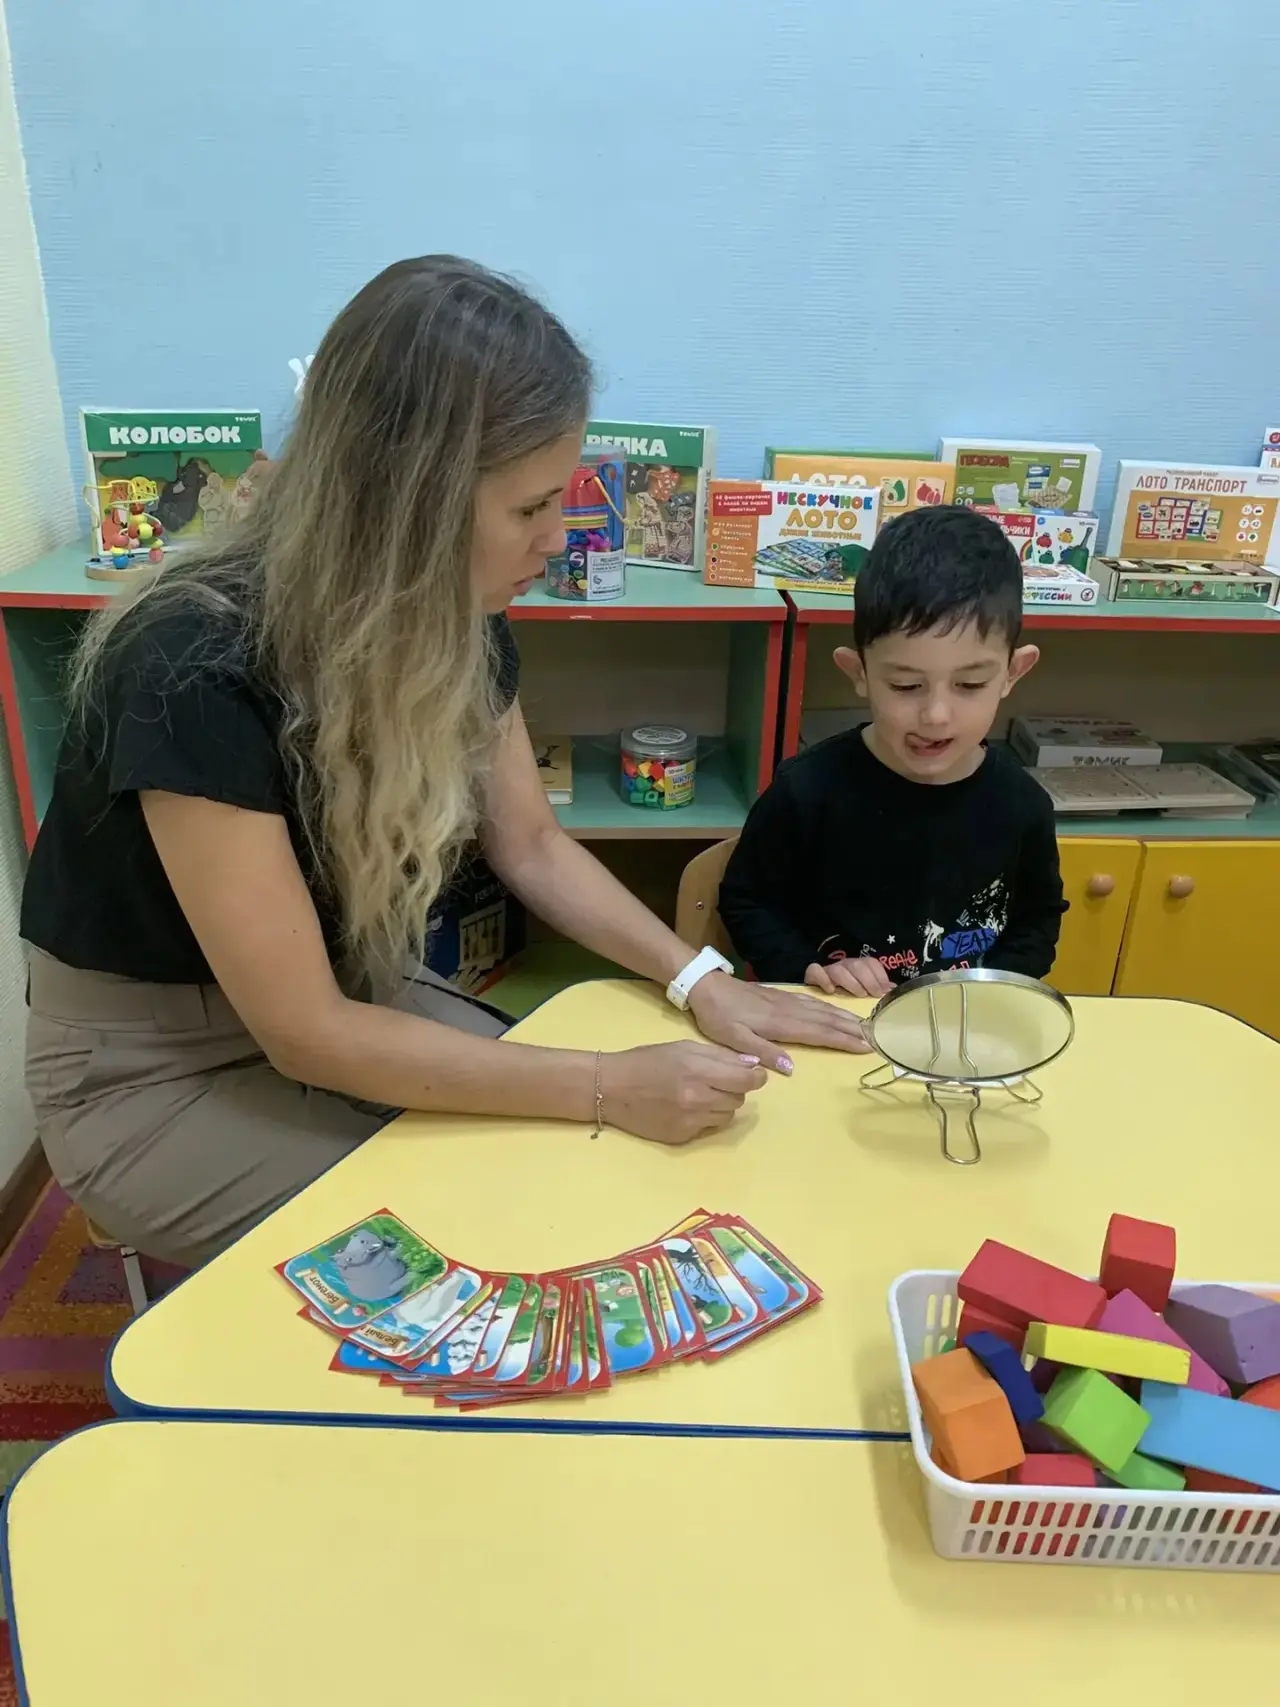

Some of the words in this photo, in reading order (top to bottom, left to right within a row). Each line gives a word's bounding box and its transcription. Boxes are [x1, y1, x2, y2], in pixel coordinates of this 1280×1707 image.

[108, 425, 241, 445] КОЛОБОК
[1136, 475, 1168, 489] ЛОТО
[1174, 477, 1247, 493] ТРАНСПОРТ
[777, 491, 873, 510] НЕСКУЧНОЕ
[786, 508, 857, 530] ЛОТО
